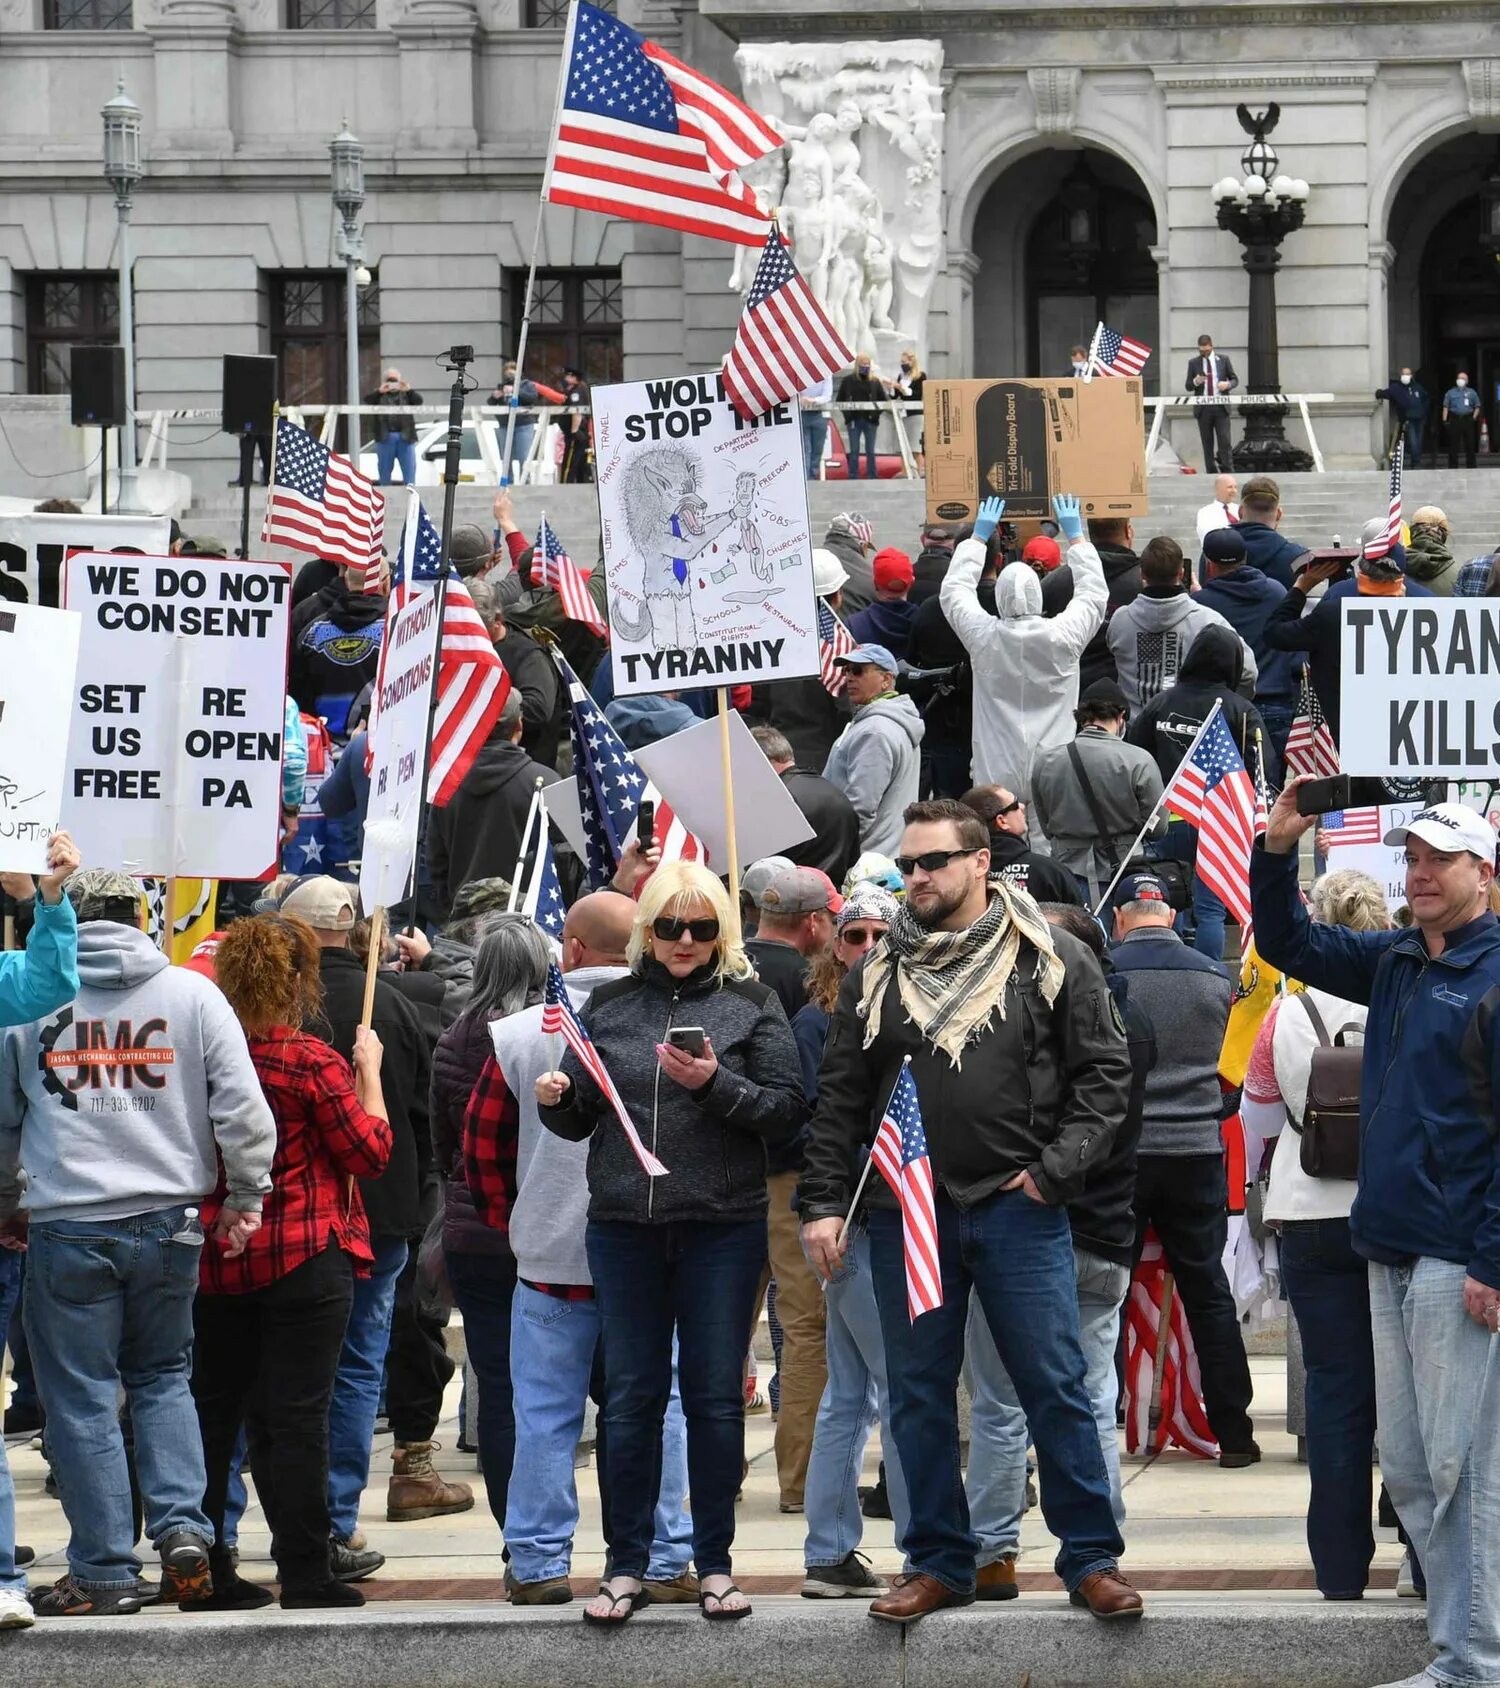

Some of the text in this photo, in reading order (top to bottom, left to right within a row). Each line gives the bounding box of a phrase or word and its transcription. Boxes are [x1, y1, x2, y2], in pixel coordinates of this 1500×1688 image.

[1196, 395, 1266, 404] CAPITOL POLICE
[600, 412, 610, 450] TRAVEL
[624, 407, 712, 443] STOP
[713, 429, 760, 453] DEPARTMENT
[731, 437, 759, 453] STORES
[1006, 393, 1018, 491] Tri-Fold Display Board
[599, 454, 622, 485] PARKS
[758, 460, 790, 489] FREEDOM
[761, 508, 790, 527] JOBS
[766, 532, 808, 557] CHURCHES
[608, 558, 629, 578] GYMS
[87, 566, 290, 604] WE DO NOT
[609, 581, 642, 606] SECURITY
[97, 601, 273, 638] CONSENT
[395, 598, 434, 650] WITHOUT
[702, 605, 742, 626] SCHOOLS
[762, 601, 807, 638] RESTAURANTS
[699, 624, 759, 640] CONSTITUTIONAL
[721, 632, 750, 643] RIGHTS
[621, 638, 785, 683] TYRANNY
[380, 653, 432, 714] CONDITIONS
[80, 684, 146, 714] SET
[202, 687, 246, 717] RE
[92, 726, 141, 756] US
[185, 730, 281, 761] OPEN
[74, 768, 161, 800] FREE
[201, 778, 253, 809] PA
[50, 1052, 173, 1063] JASON'S MECHANICAL CONTRACTING LLC
[67, 1018, 168, 1091] JMC
[90, 1096, 156, 1112] 717-333-6202
